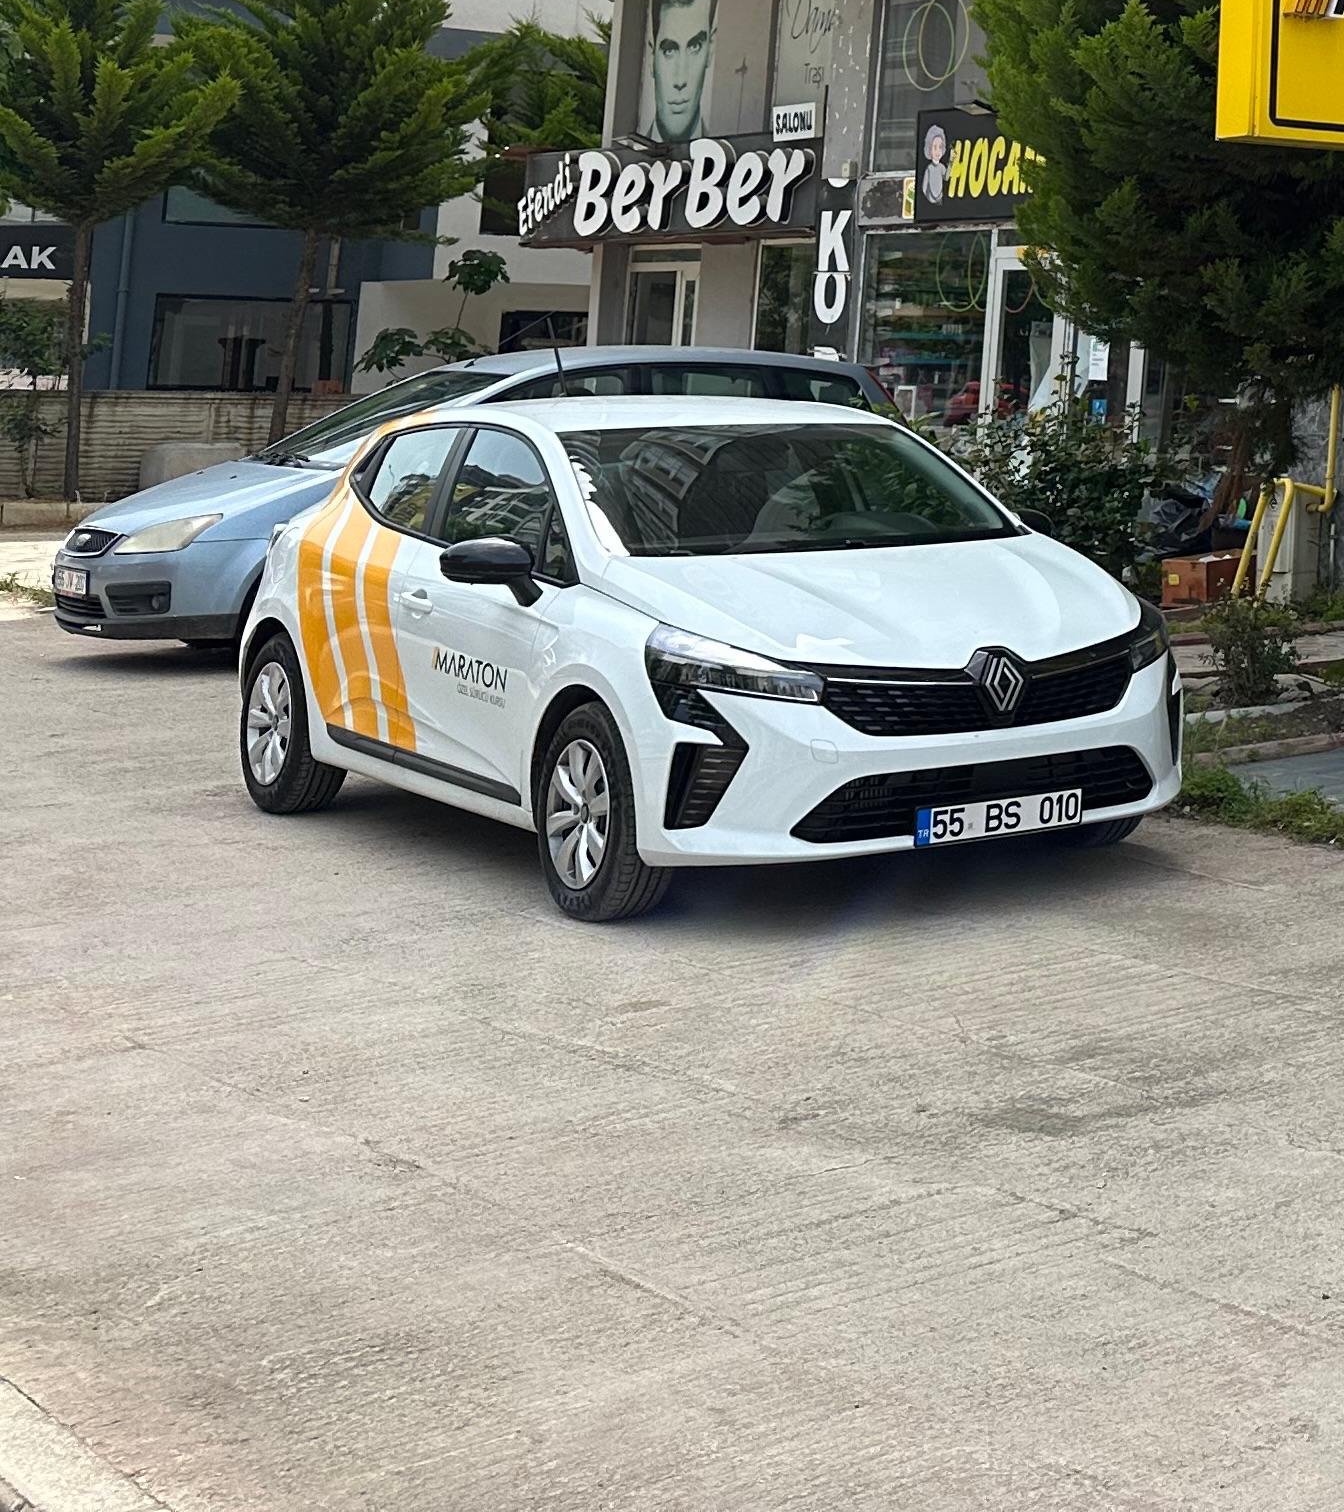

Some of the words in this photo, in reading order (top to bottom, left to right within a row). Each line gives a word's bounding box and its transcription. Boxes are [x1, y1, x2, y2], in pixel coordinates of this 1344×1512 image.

[775, 108, 813, 135] SALONU
[948, 136, 1046, 198] HOCA
[517, 152, 573, 236] Efendi
[435, 648, 507, 693] MARATON
[918, 828, 929, 838] TR
[932, 807, 966, 840] 55
[984, 800, 1022, 834] BS
[1039, 792, 1079, 825] 010
